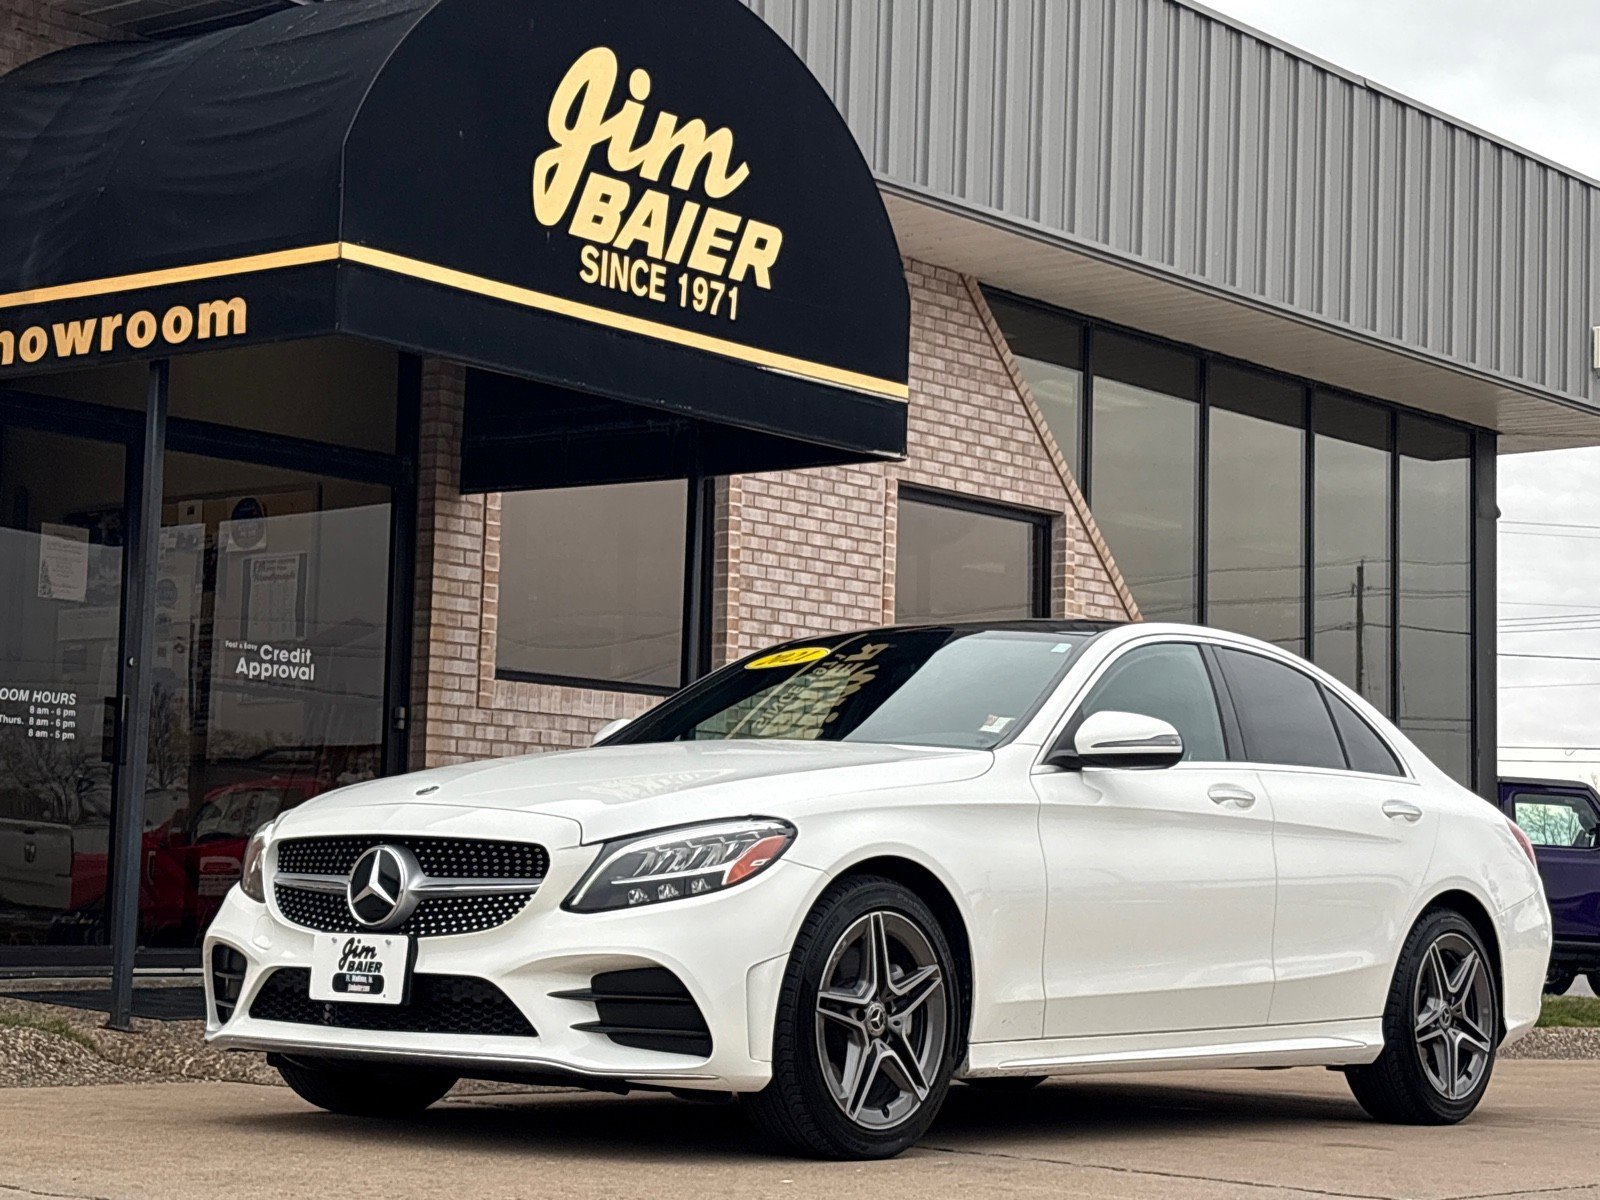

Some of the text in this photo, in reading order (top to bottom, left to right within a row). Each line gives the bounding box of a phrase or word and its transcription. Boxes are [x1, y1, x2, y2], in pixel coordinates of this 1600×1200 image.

[532, 46, 750, 226] Jim
[568, 171, 783, 290] BAIER
[579, 245, 738, 321] SINCE 1971
[244, 642, 258, 651] Easy
[260, 644, 311, 665] Credit
[235, 657, 315, 681] Approval
[32, 690, 77, 705] HOURS
[0, 714, 25, 725] Thurs.
[28, 716, 34, 726] 8
[35, 718, 49, 726] am
[55, 719, 61, 727] 6
[62, 720, 76, 730] pm
[36, 707, 49, 715] am
[63, 708, 76, 718] pm
[28, 728, 34, 737] 8
[35, 730, 48, 738] am
[61, 731, 75, 741] pm
[338, 936, 378, 971] Jim
[346, 960, 383, 974] BAIER
